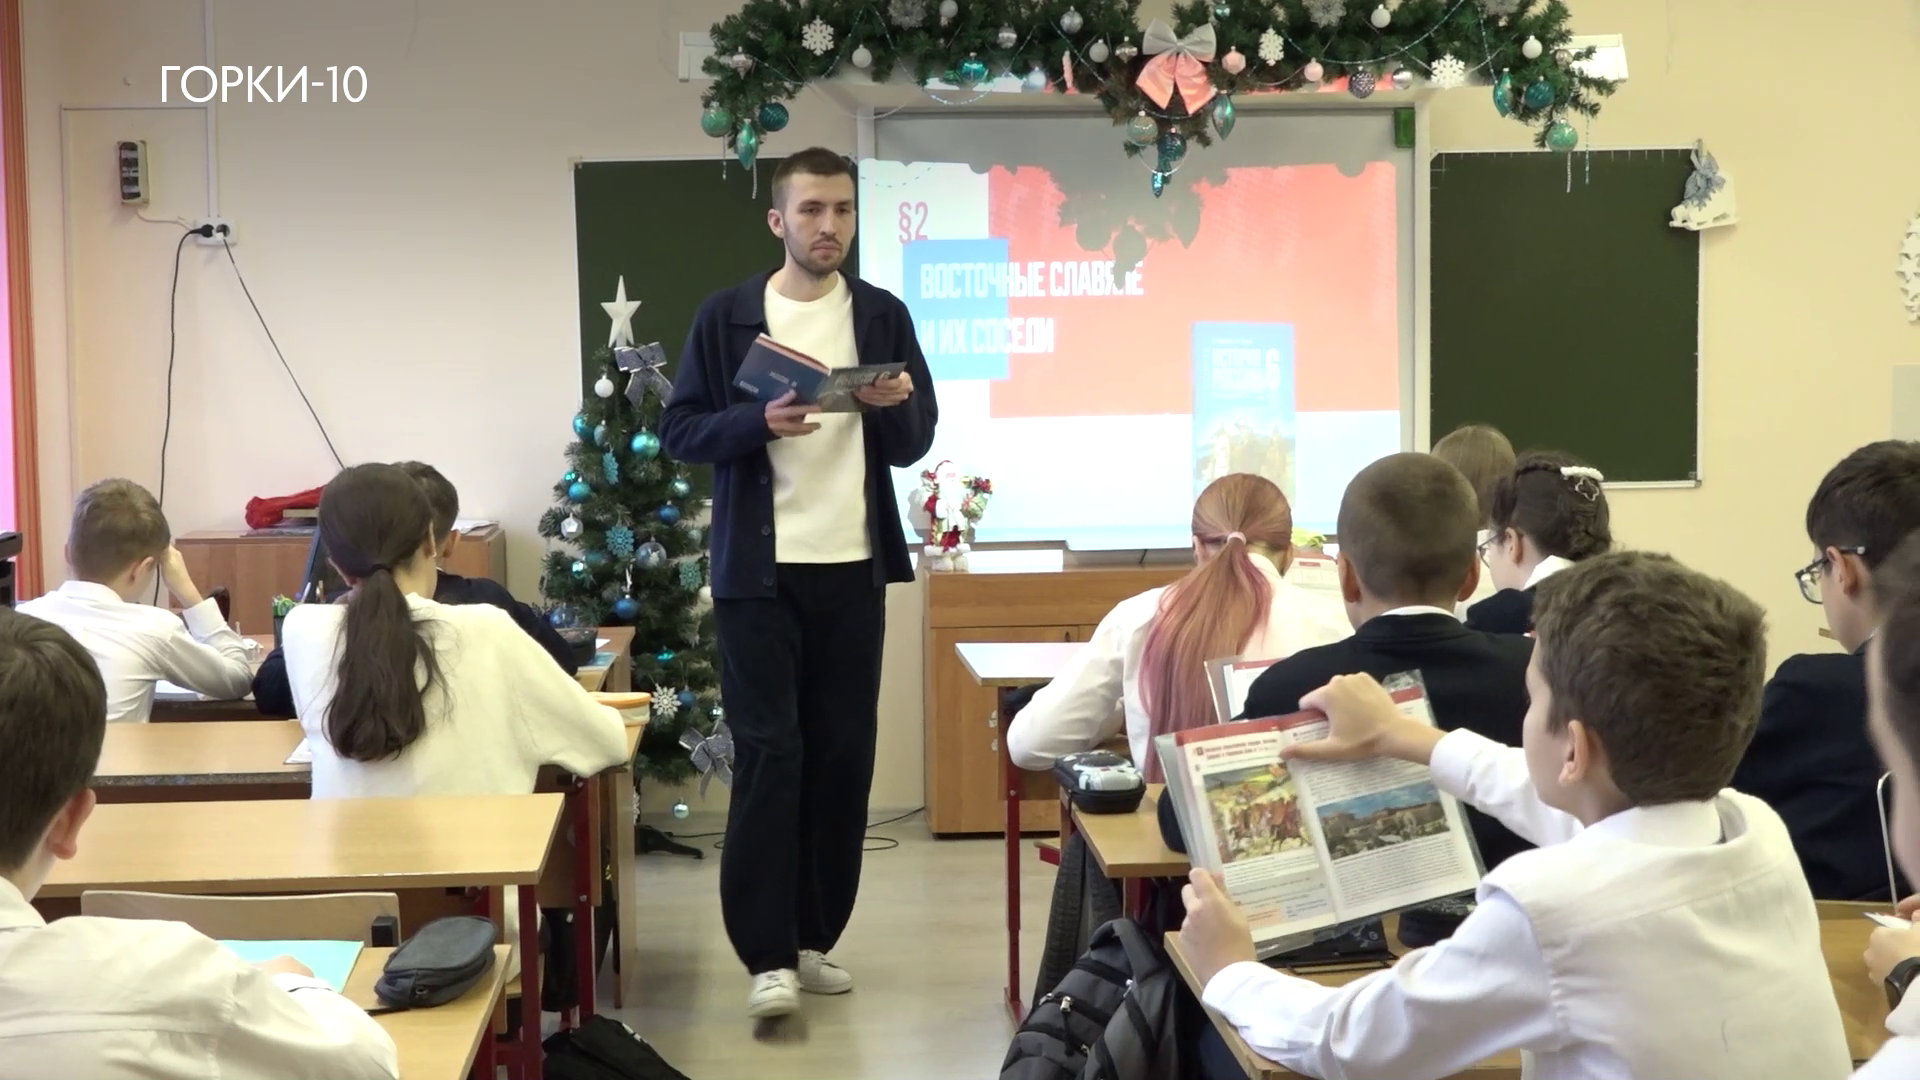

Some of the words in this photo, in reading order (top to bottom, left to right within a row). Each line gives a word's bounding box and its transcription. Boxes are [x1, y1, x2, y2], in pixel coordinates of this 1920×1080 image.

[898, 202, 929, 244] §2
[920, 261, 1046, 299] ВОСТОЧНЫЕ
[920, 319, 935, 355] И
[939, 319, 968, 355] ИХ
[971, 317, 1055, 354] СОСЕДИ
